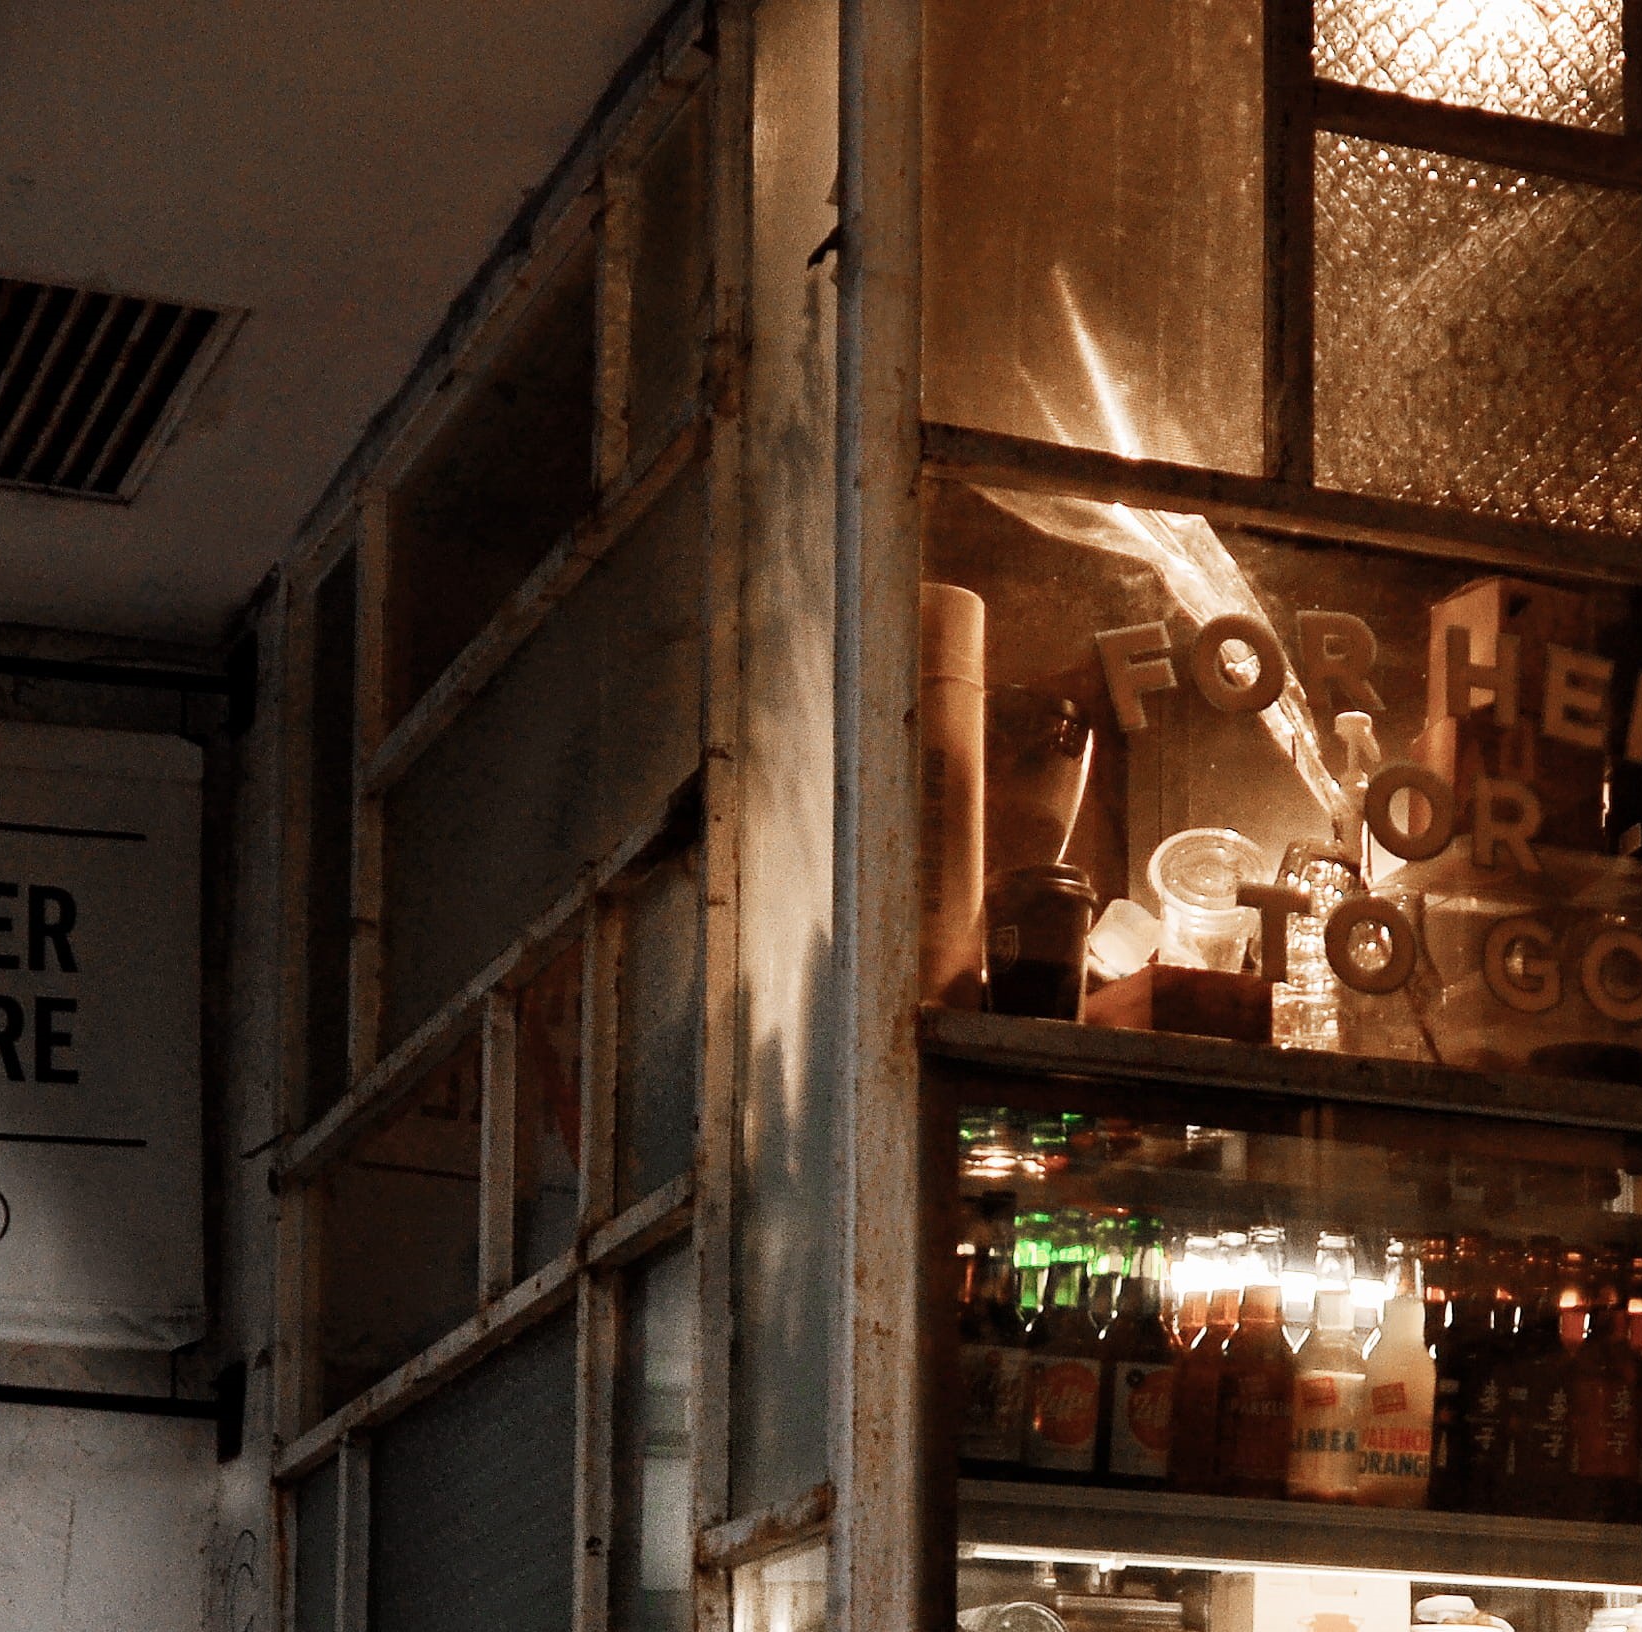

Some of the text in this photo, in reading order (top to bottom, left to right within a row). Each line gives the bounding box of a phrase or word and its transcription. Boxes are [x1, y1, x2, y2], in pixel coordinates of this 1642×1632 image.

[1094, 609, 1387, 733] FOR
[1365, 759, 1547, 872] OR
[1237, 880, 1421, 996] TO
